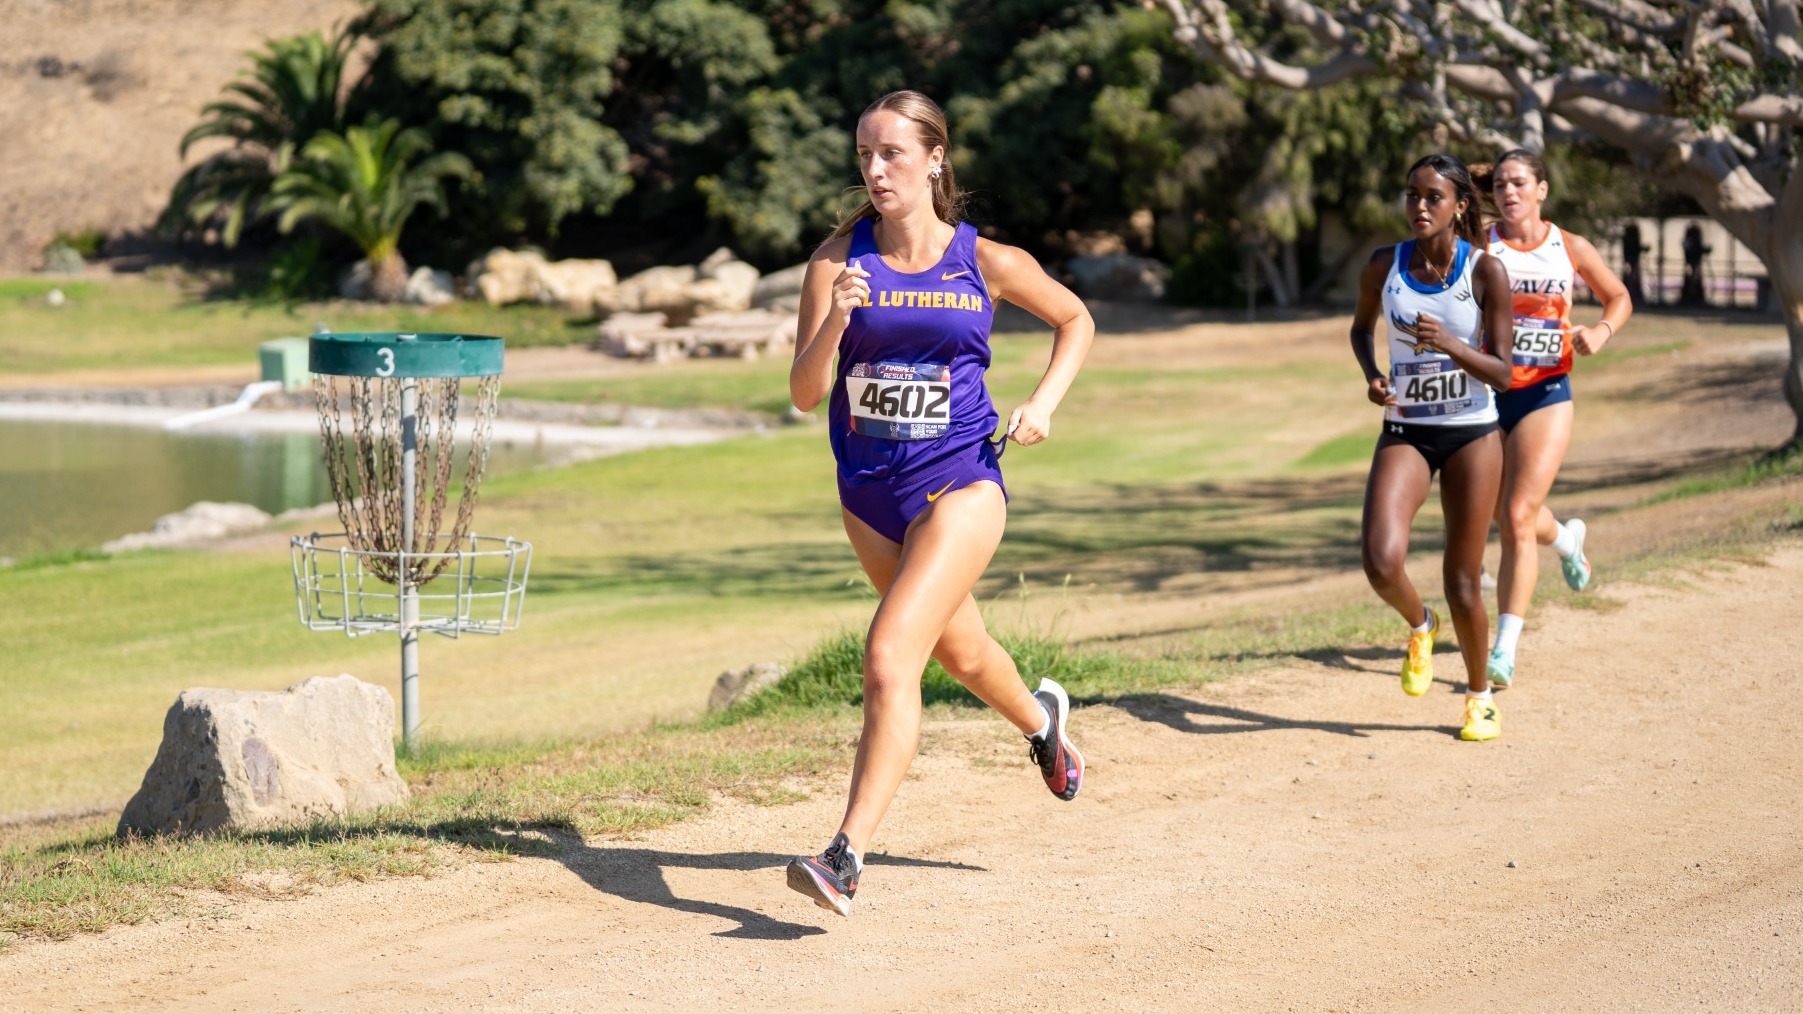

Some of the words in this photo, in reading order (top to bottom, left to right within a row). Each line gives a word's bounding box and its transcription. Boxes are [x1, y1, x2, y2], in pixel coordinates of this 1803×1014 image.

[879, 290, 983, 312] LUTHERAN
[375, 347, 395, 377] 3
[883, 372, 913, 380] RESULTS
[859, 383, 950, 418] 4602
[1405, 372, 1467, 402] 4610
